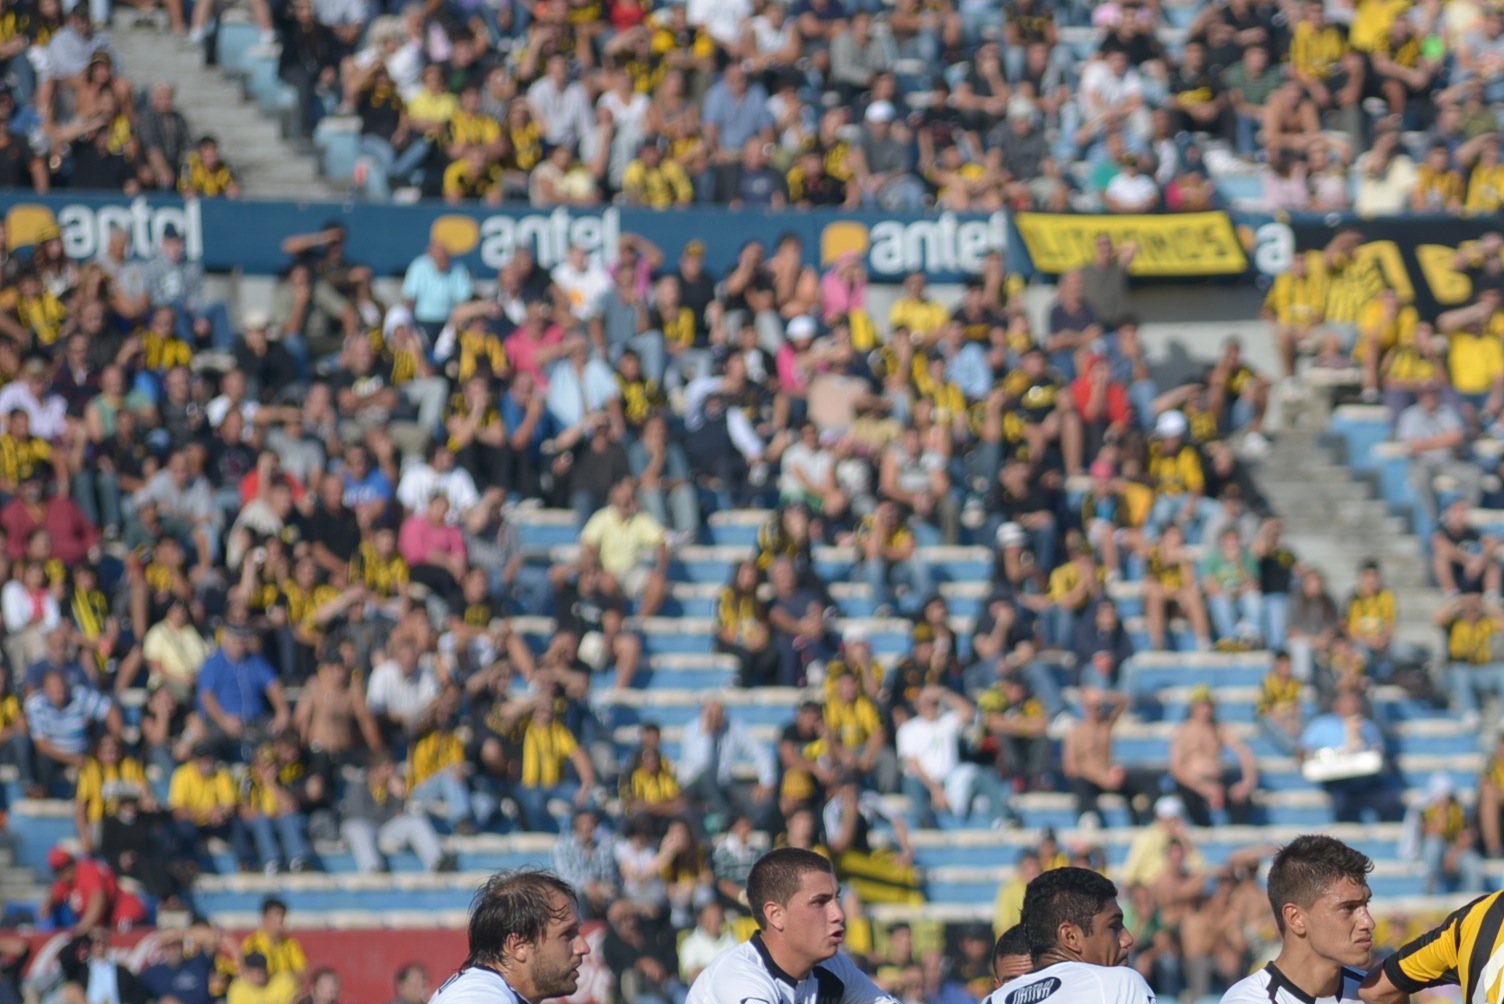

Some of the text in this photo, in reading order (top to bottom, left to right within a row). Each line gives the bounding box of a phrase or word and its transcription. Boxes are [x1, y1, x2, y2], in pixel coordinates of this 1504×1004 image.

[59, 195, 203, 261] antel
[481, 204, 619, 270] antel
[869, 209, 1007, 274] antel
